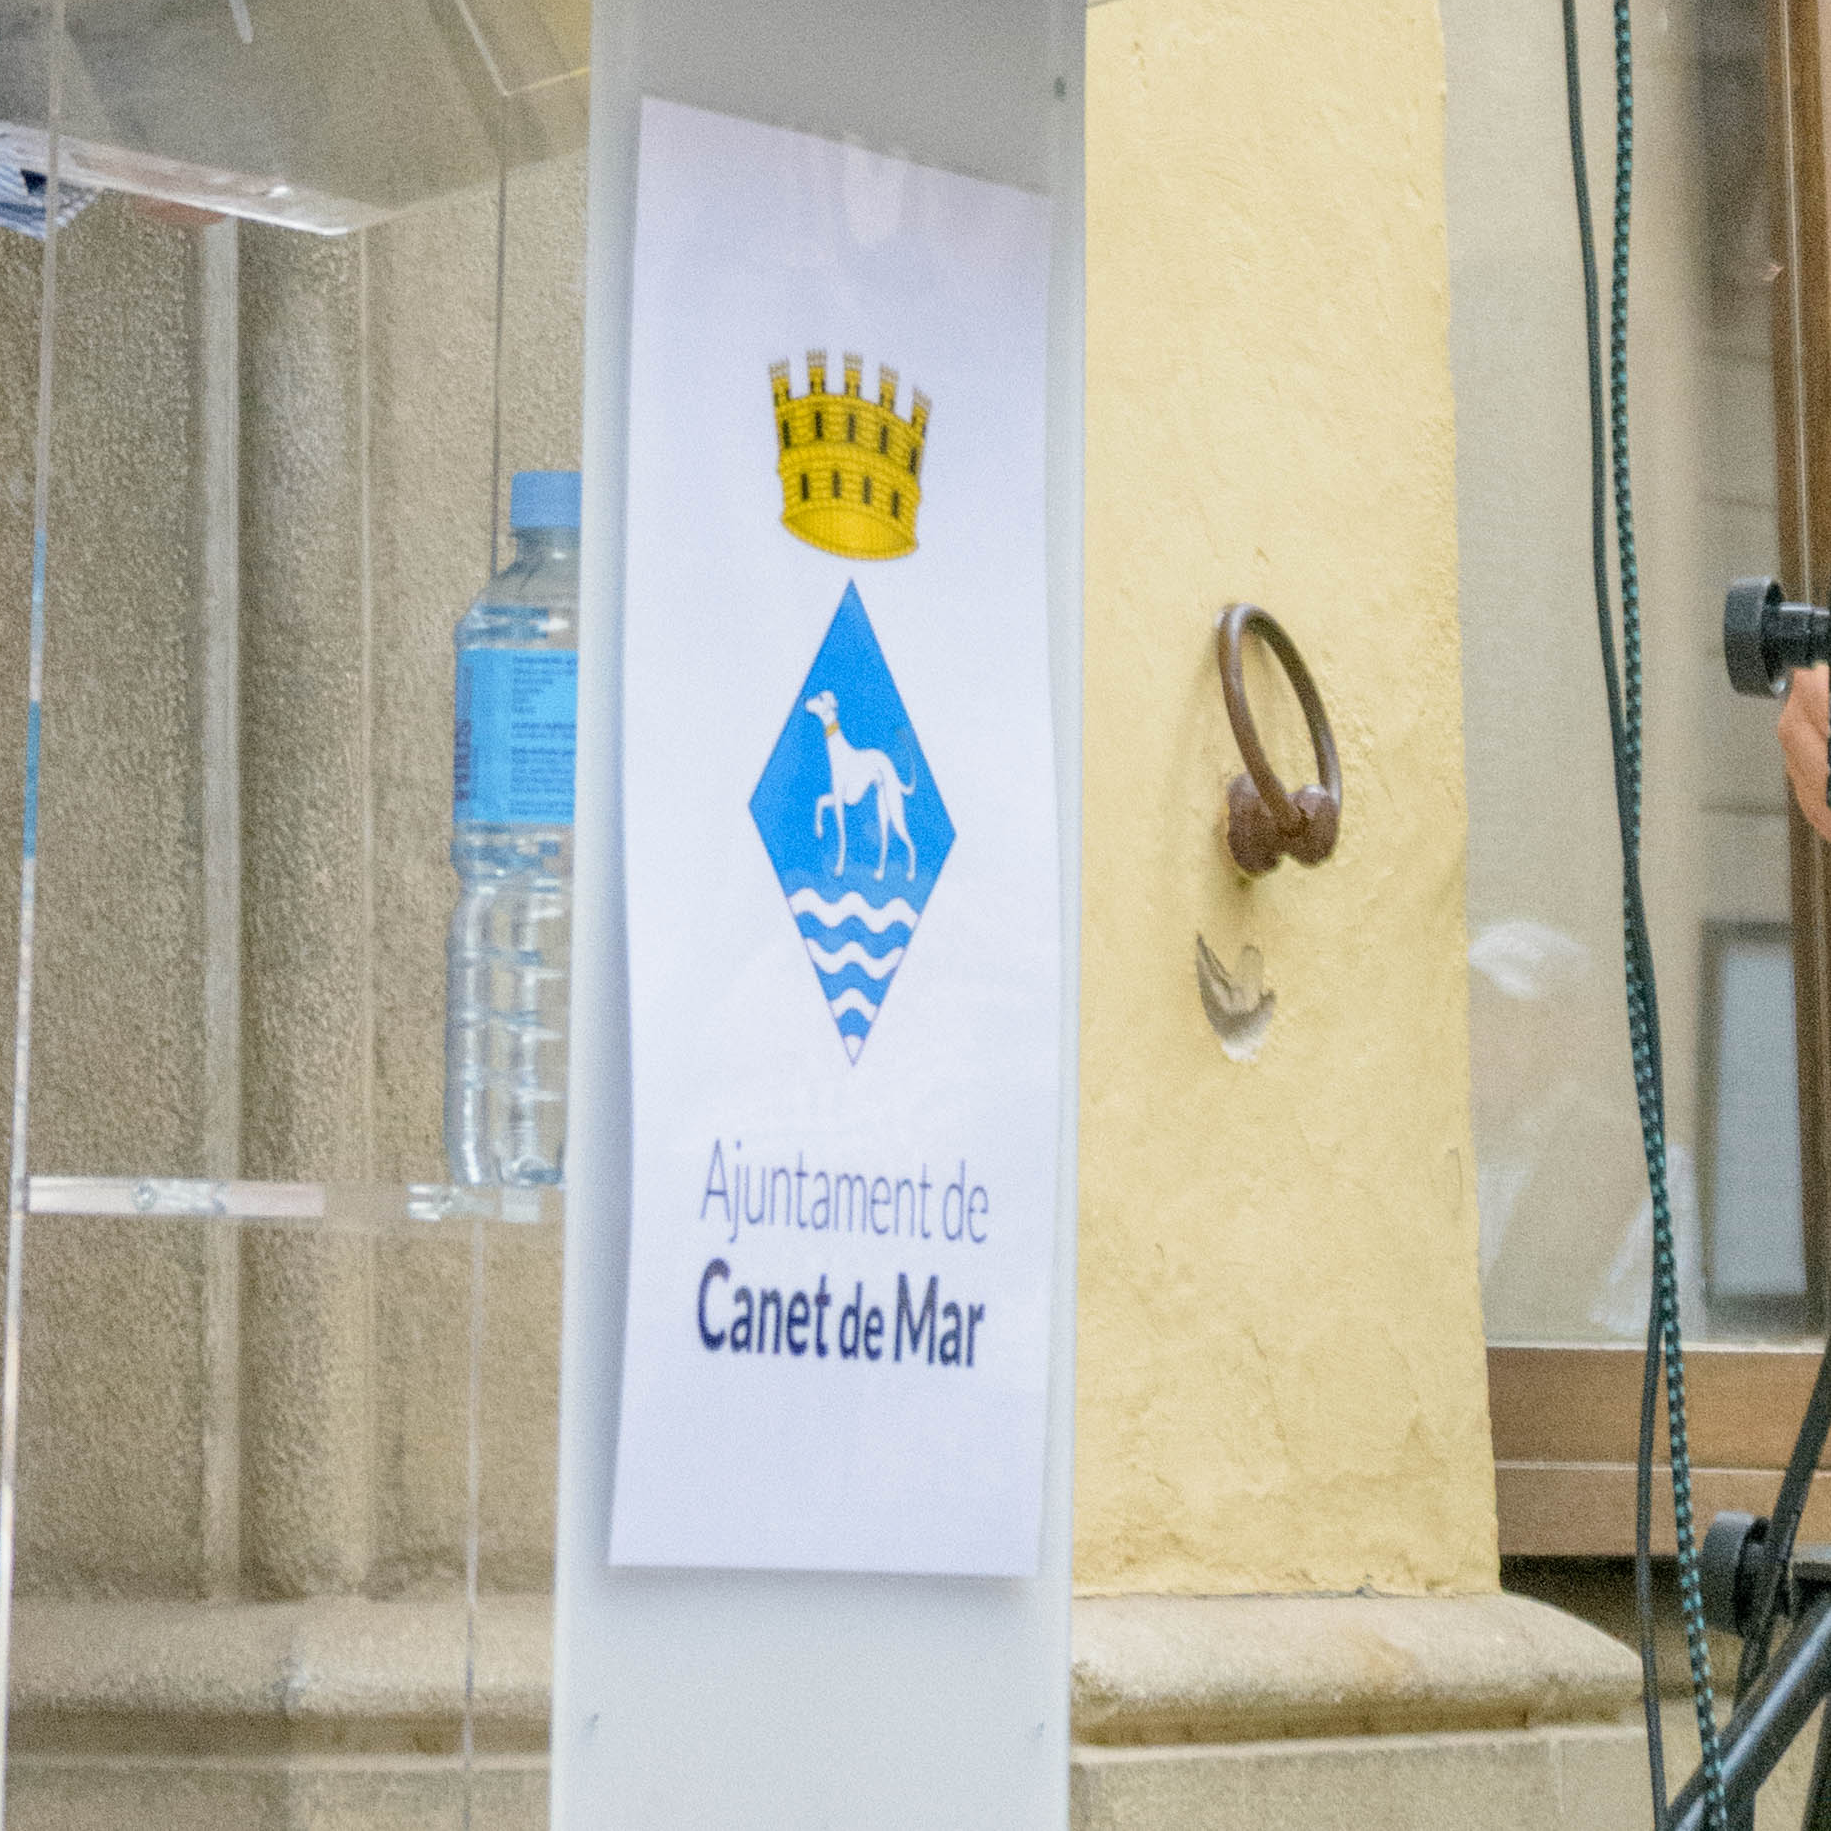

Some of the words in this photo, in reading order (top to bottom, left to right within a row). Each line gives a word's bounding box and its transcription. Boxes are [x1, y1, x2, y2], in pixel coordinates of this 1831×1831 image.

[700, 1139, 932, 1243] Ajuntament
[942, 1159, 989, 1243] de
[697, 1257, 832, 1358] Canet
[839, 1281, 884, 1361] de
[893, 1272, 986, 1368] Mar
